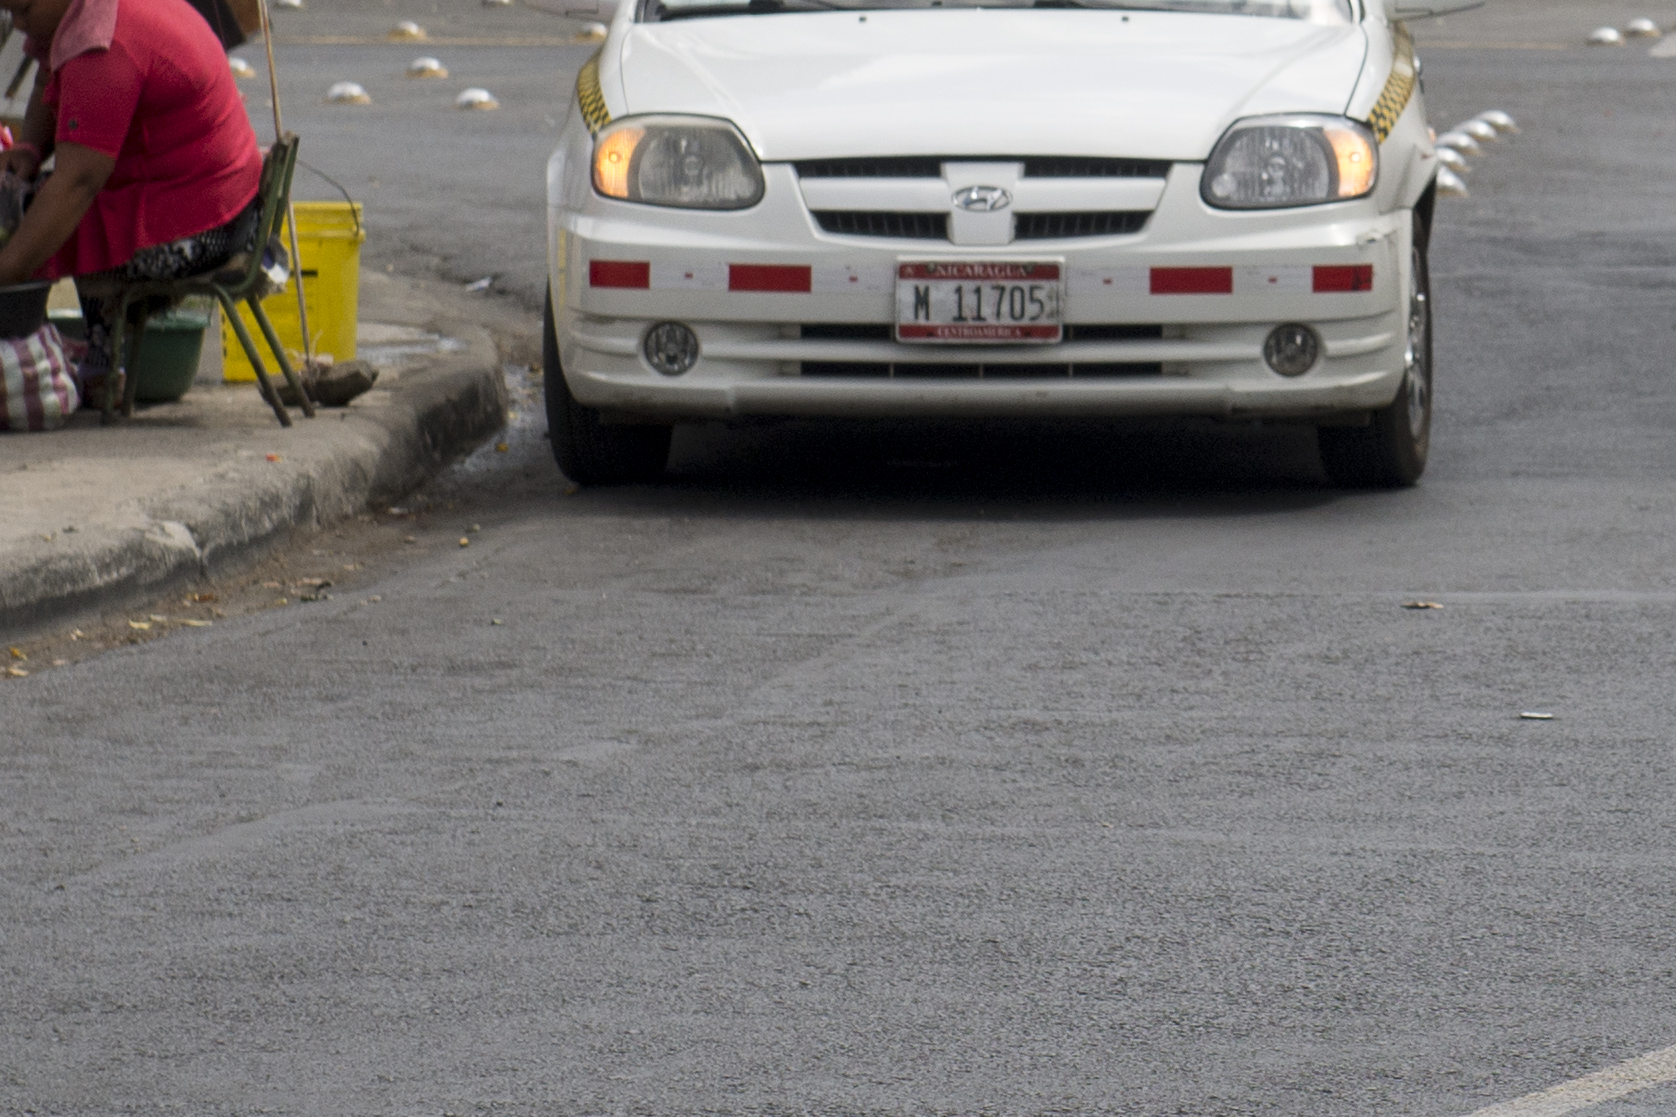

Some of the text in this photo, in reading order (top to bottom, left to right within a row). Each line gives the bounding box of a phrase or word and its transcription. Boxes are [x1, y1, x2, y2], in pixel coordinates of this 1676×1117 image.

[935, 264, 1028, 278] NICARAGUA
[913, 284, 931, 322] M
[952, 284, 1045, 322] 11705
